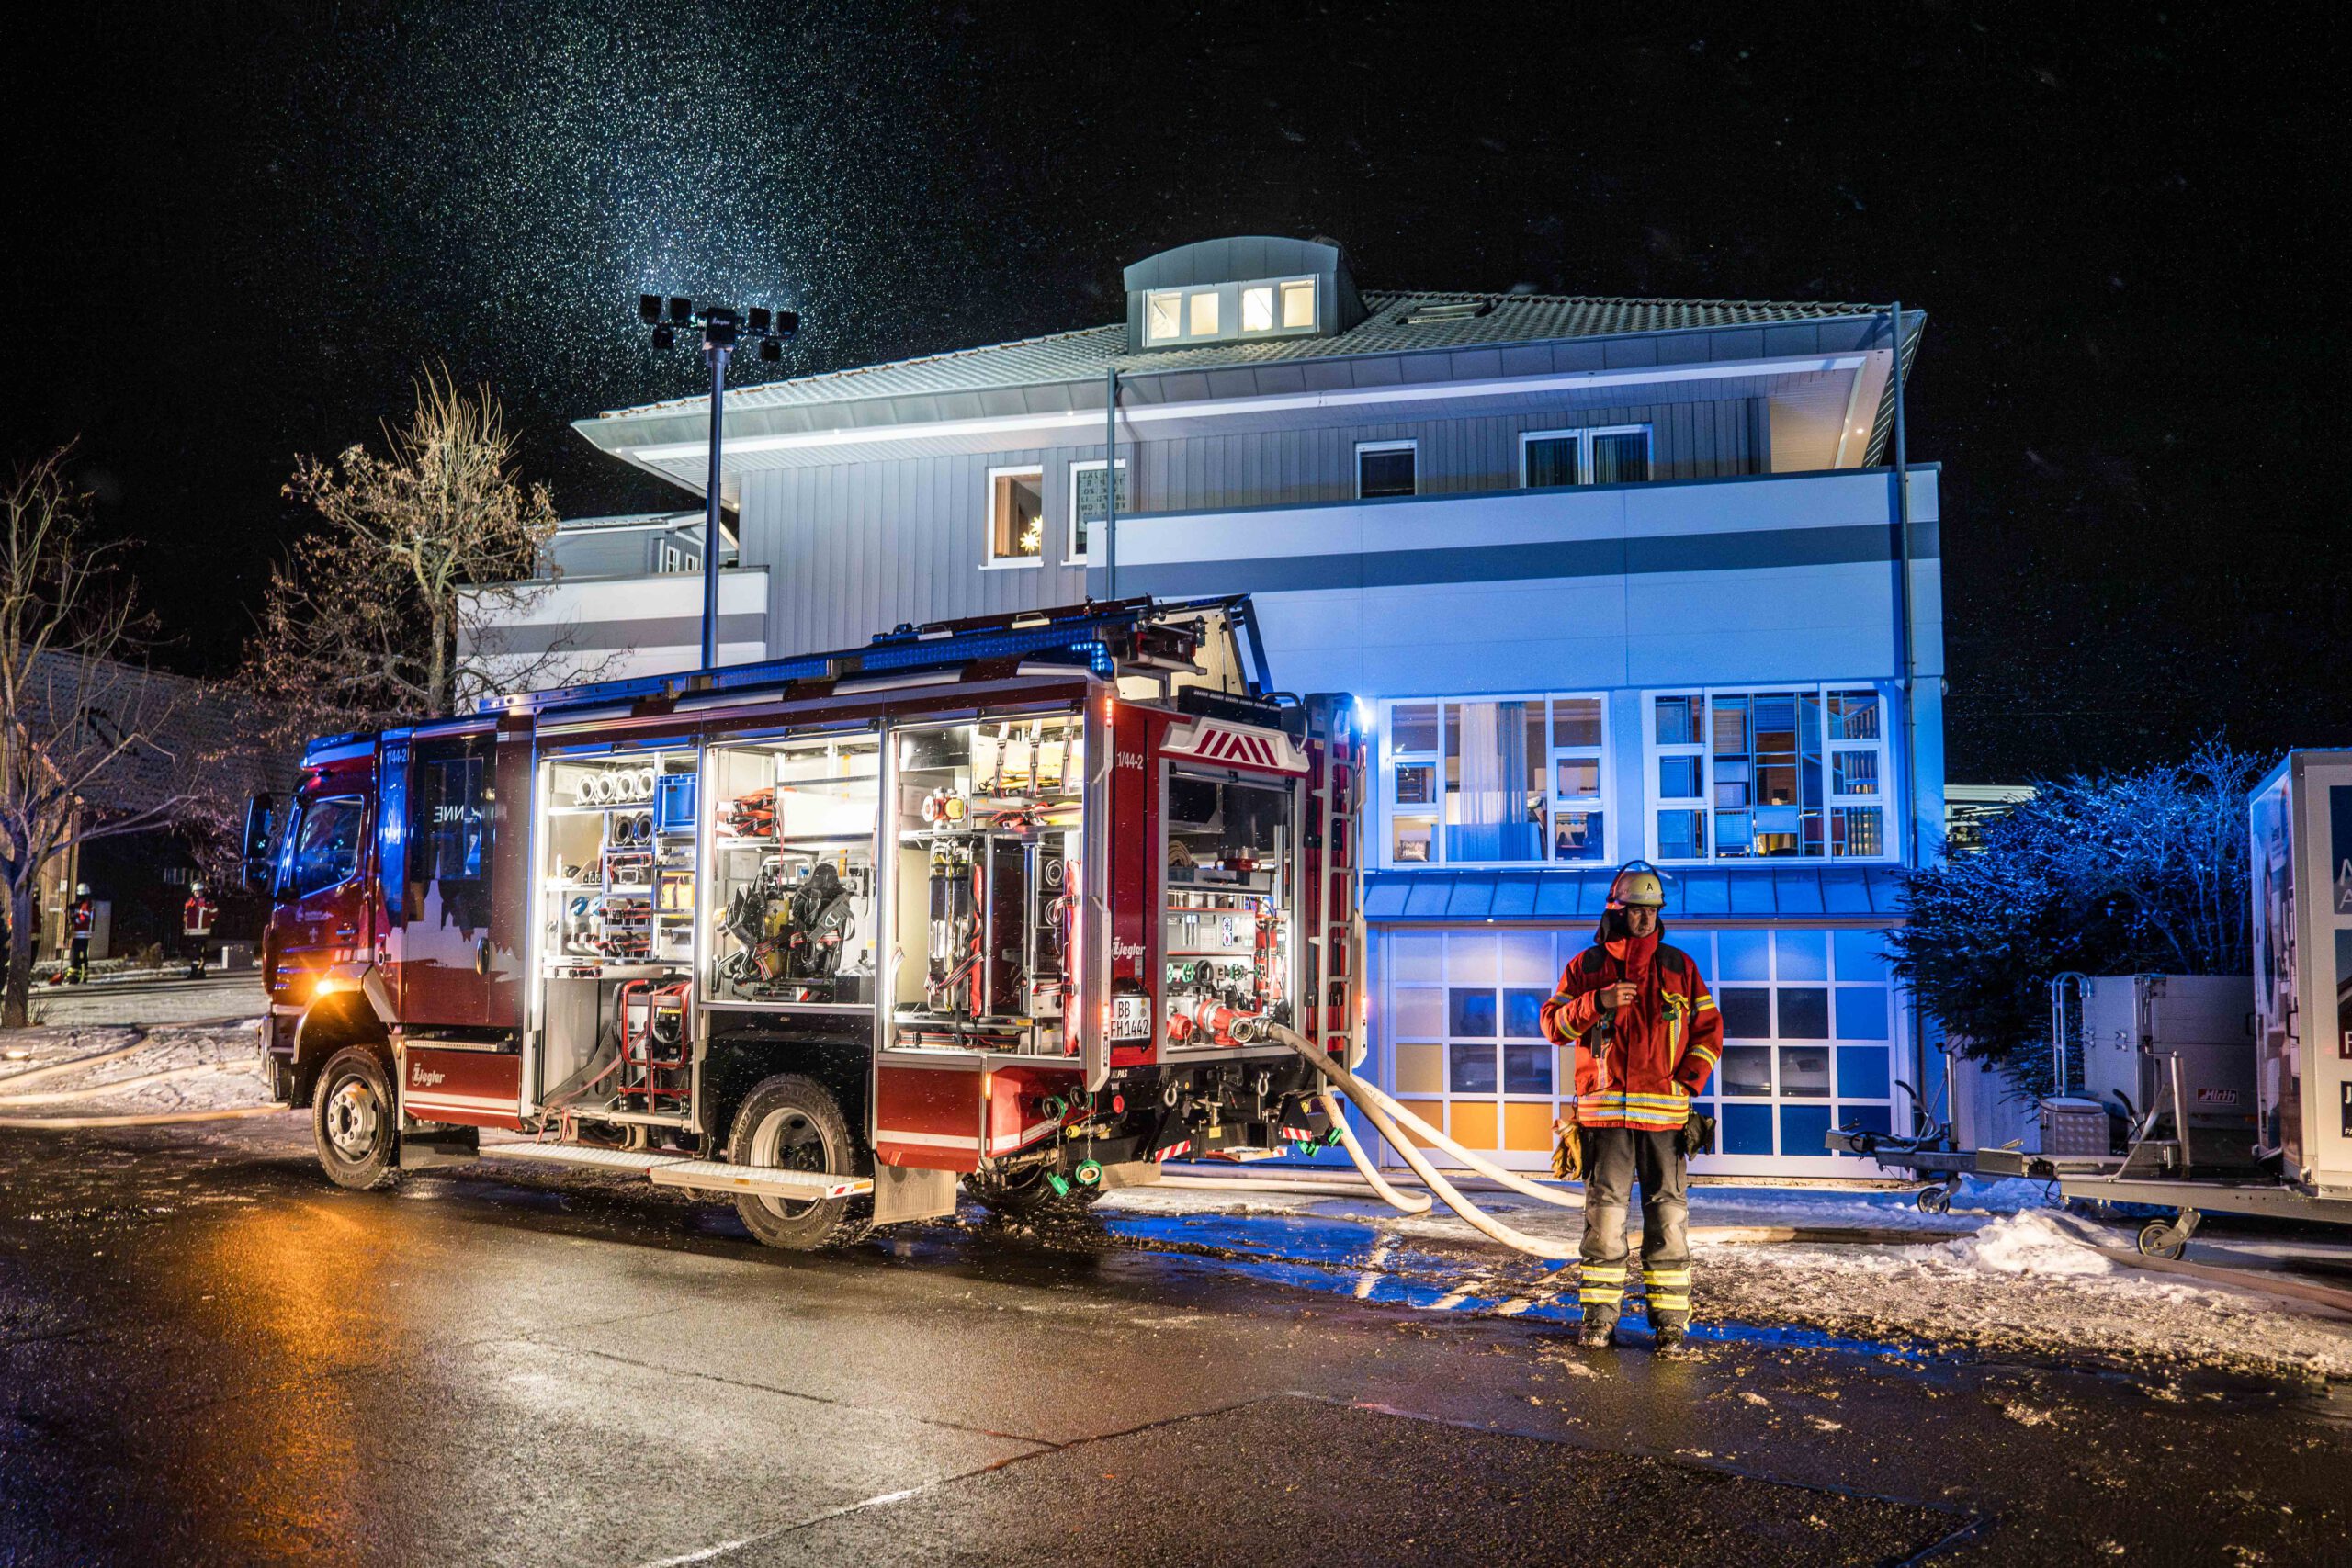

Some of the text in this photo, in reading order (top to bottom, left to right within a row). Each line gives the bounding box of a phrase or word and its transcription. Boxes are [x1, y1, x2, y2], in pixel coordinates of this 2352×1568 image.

[386, 748, 407, 764] 1/44-2
[1117, 751, 1144, 770] 1/44-2
[1646, 882, 1653, 891] A
[1112, 936, 1146, 961] Ziegler
[1118, 1001, 1130, 1018] BB
[1111, 1019, 1148, 1037] FH 1442
[412, 1062, 445, 1087] Ziegler
